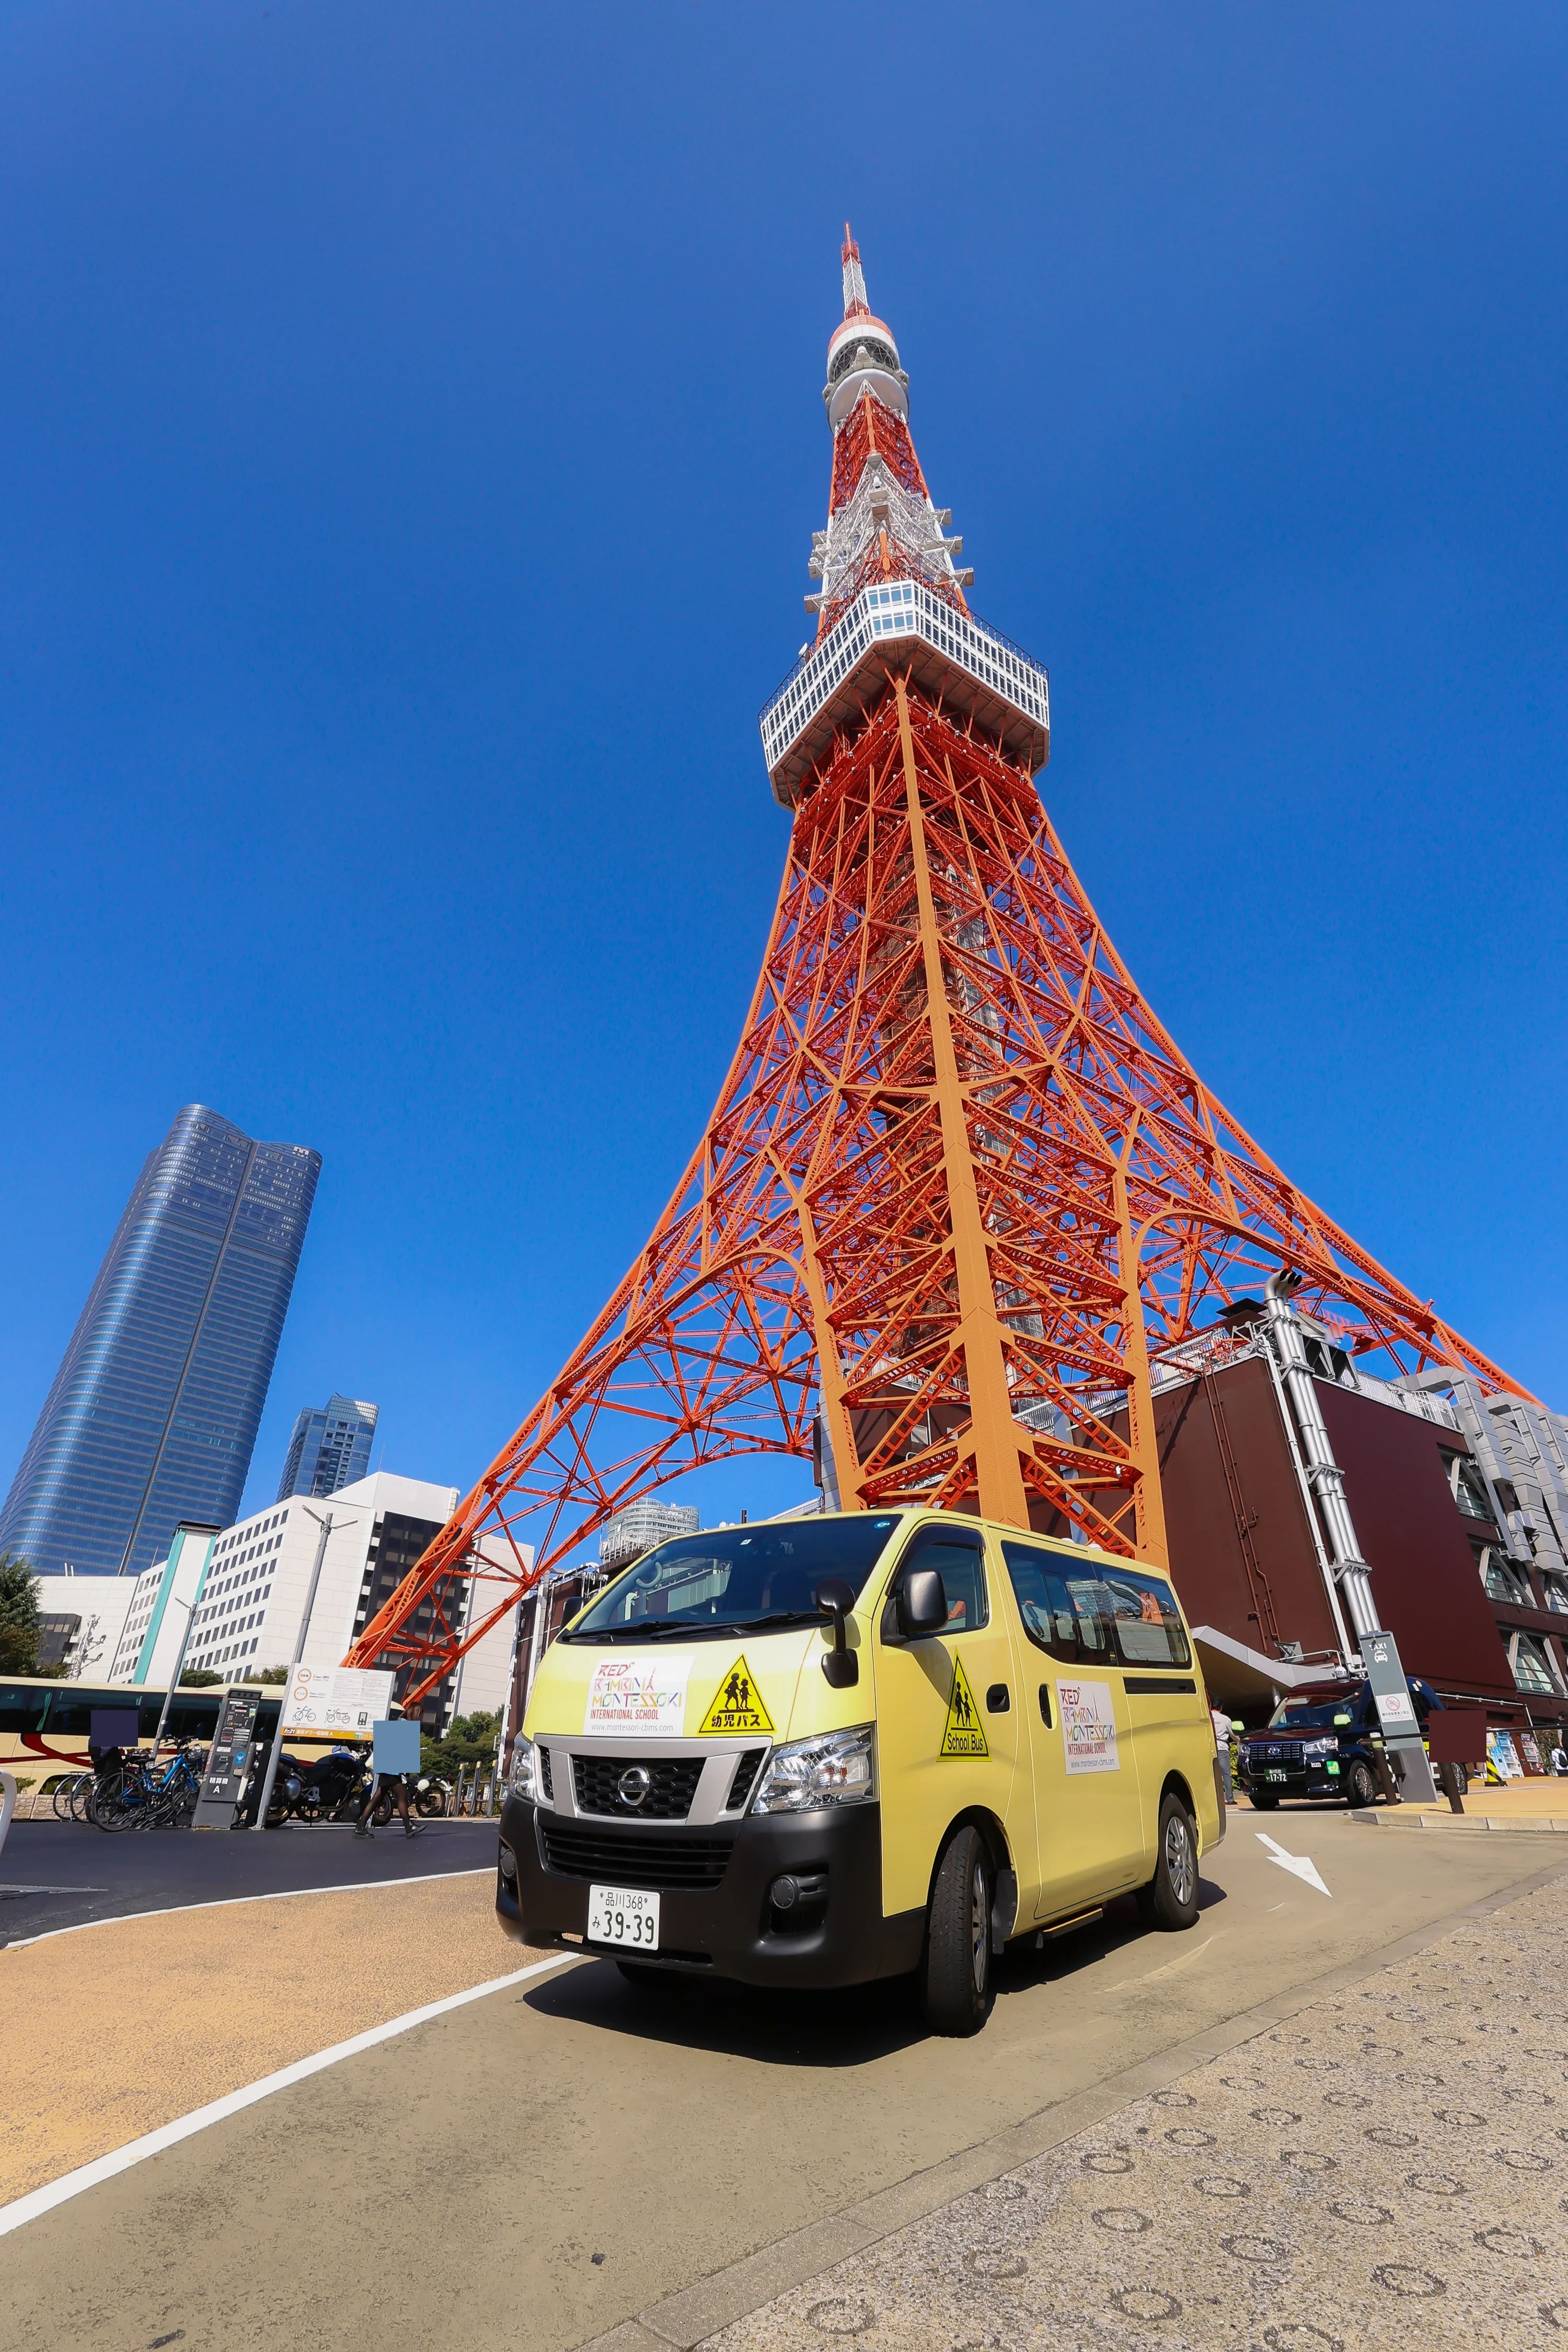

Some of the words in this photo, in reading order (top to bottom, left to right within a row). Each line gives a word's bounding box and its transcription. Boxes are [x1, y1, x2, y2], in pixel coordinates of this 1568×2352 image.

[590, 1709, 633, 1720] INTERNATIONAL
[635, 1709, 659, 1720] SCHOOL
[711, 1714, 760, 1727] 幼児バス
[592, 1723, 674, 1732] www.montessori-cbms.com
[947, 1733, 970, 1750] School
[971, 1734, 983, 1751] Bus
[1068, 1743, 1093, 1755] INTERNATIONAL
[1094, 1742, 1106, 1754] SCHOOL
[592, 1916, 601, 1929] み
[603, 1910, 654, 1944] 39-39
